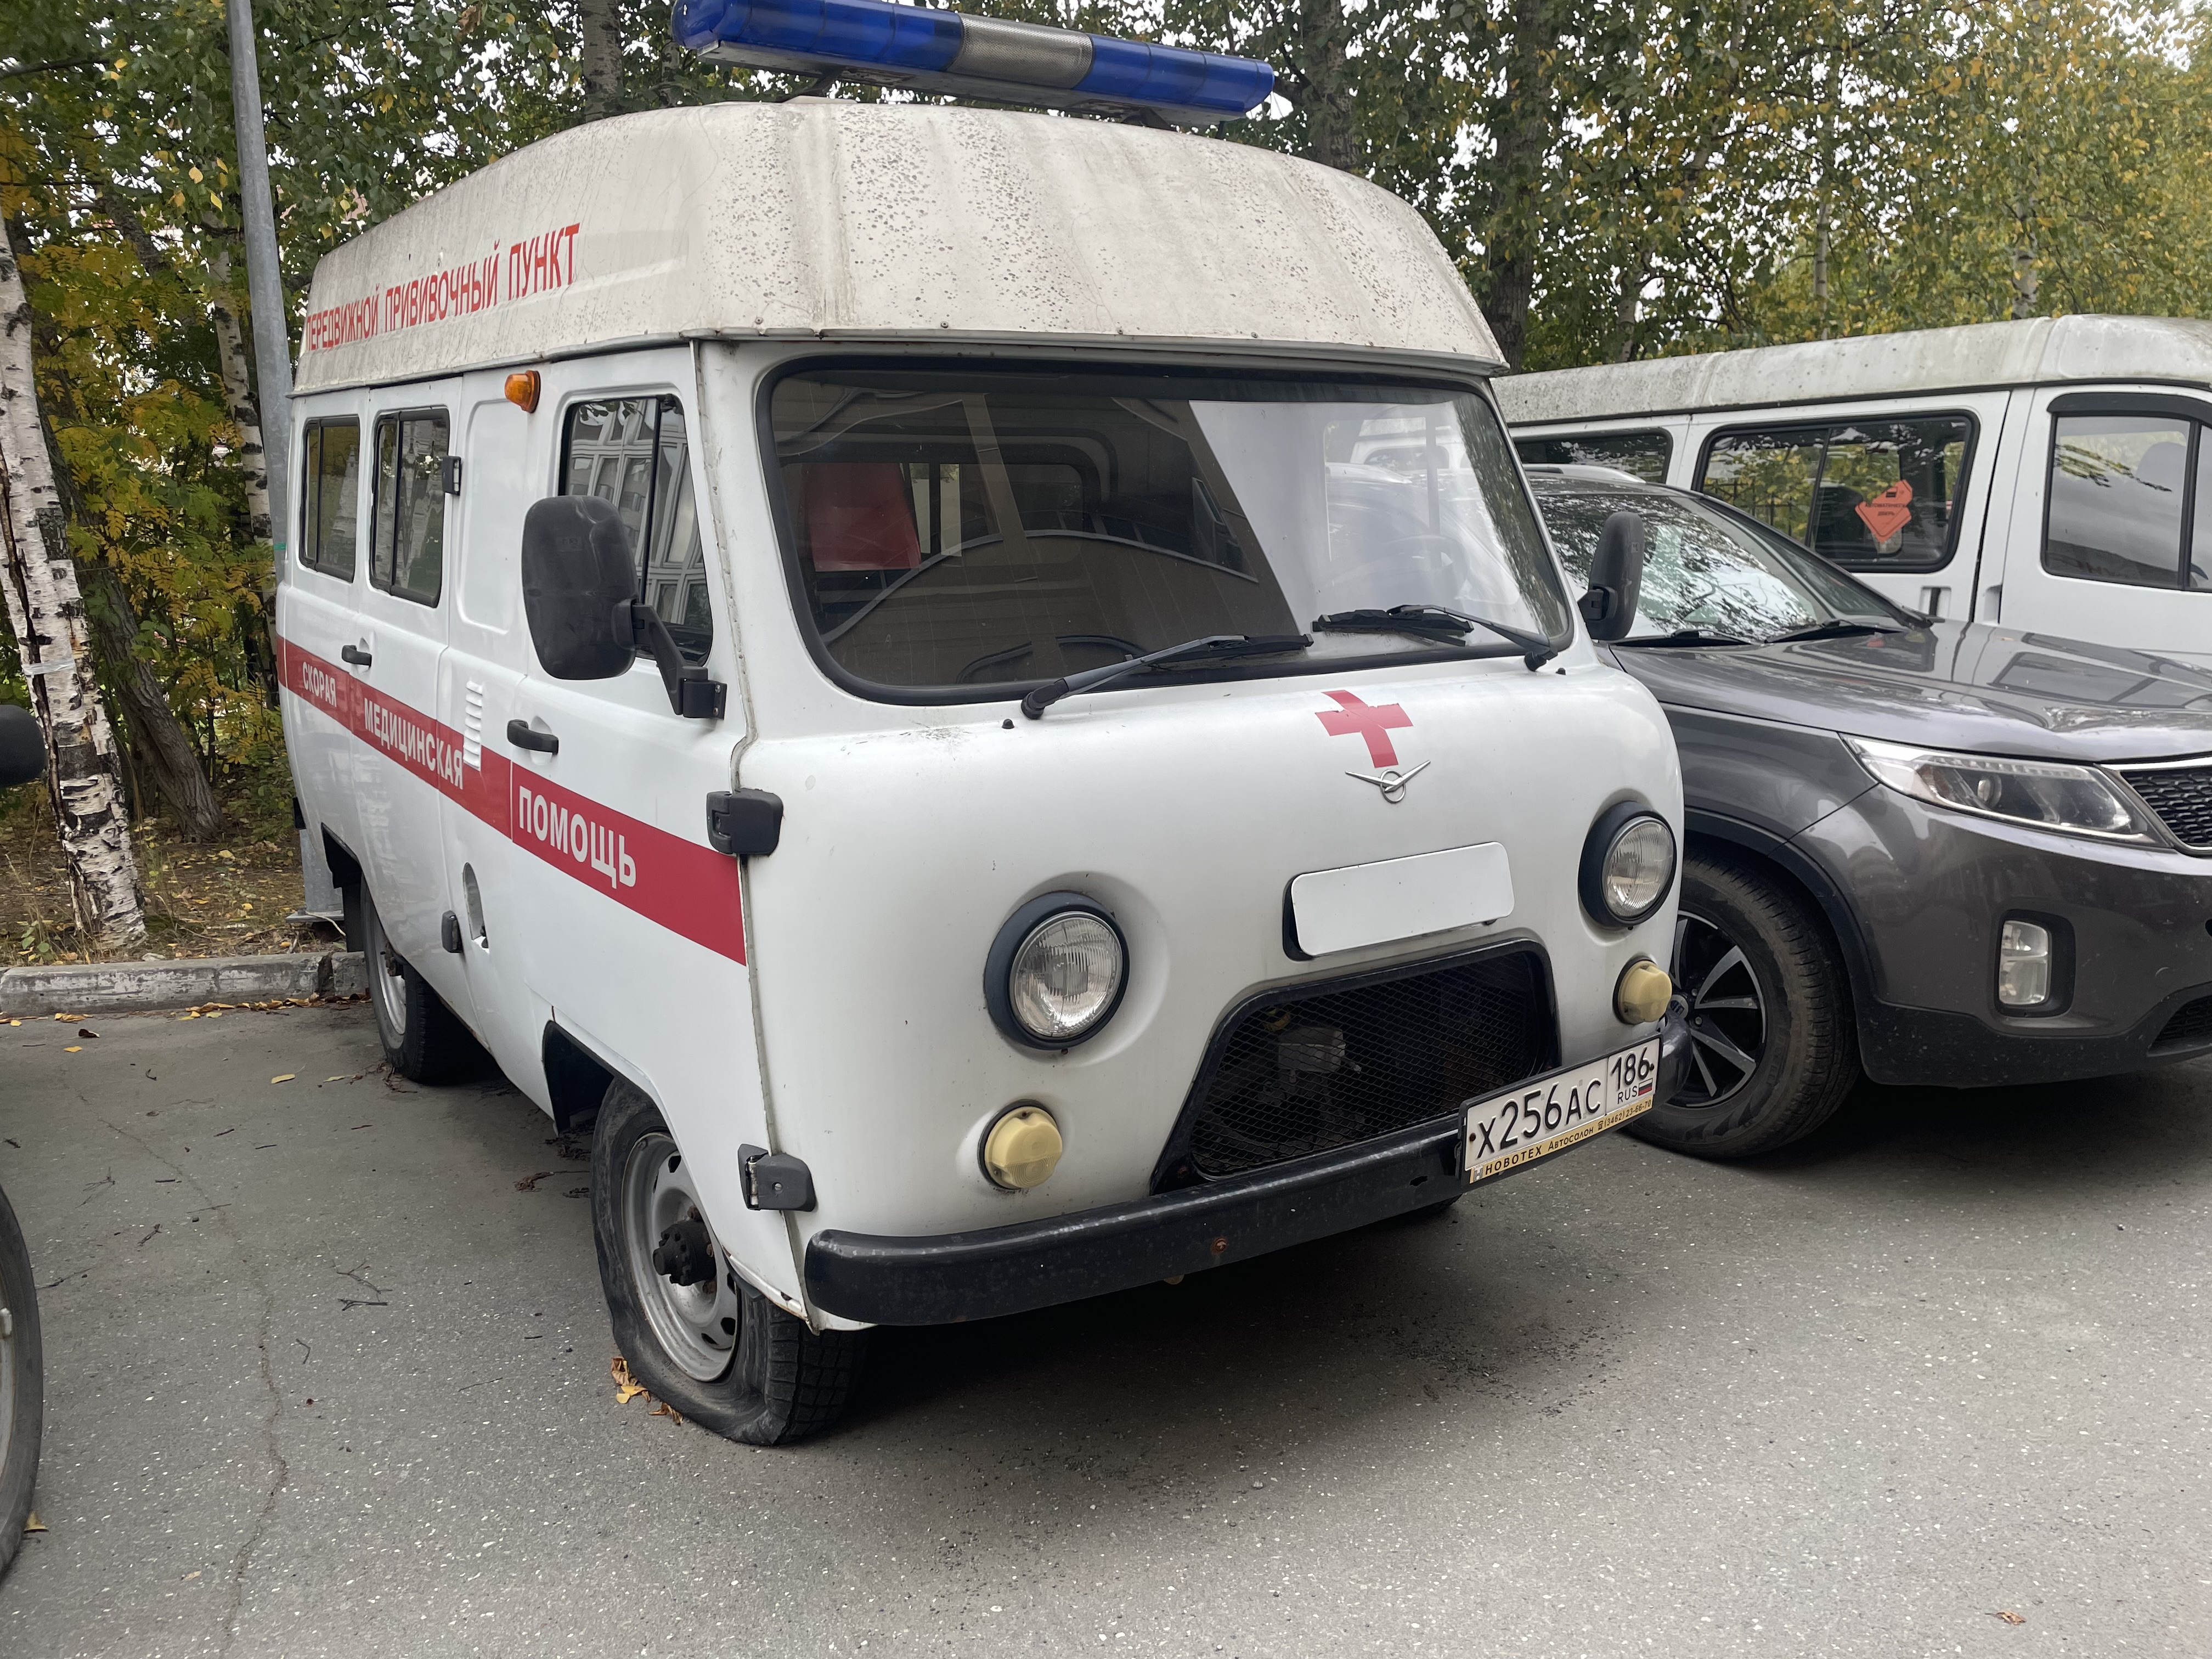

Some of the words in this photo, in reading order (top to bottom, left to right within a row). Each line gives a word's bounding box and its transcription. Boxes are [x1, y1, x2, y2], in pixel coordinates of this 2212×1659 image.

[306, 284, 380, 351] ПЕРЕДВИЖНОЙ
[385, 239, 500, 332] ПРИВИВОЧНЫЙ
[508, 223, 580, 300] ПУНКТ
[302, 662, 337, 708] СКОРАЯ
[364, 698, 464, 790] МЕДИЦИНСКАЯ
[519, 785, 637, 890] ПОМОЩЬ
[1476, 1077, 1601, 1159] Х256АС
[1610, 1047, 1651, 1091] 186
[1485, 1146, 1542, 1175] НОВОТЕХ
[1548, 1127, 1594, 1152] Автосалон
[1604, 1110, 1625, 1127] (3462)
[1617, 1085, 1638, 1104] RUS
